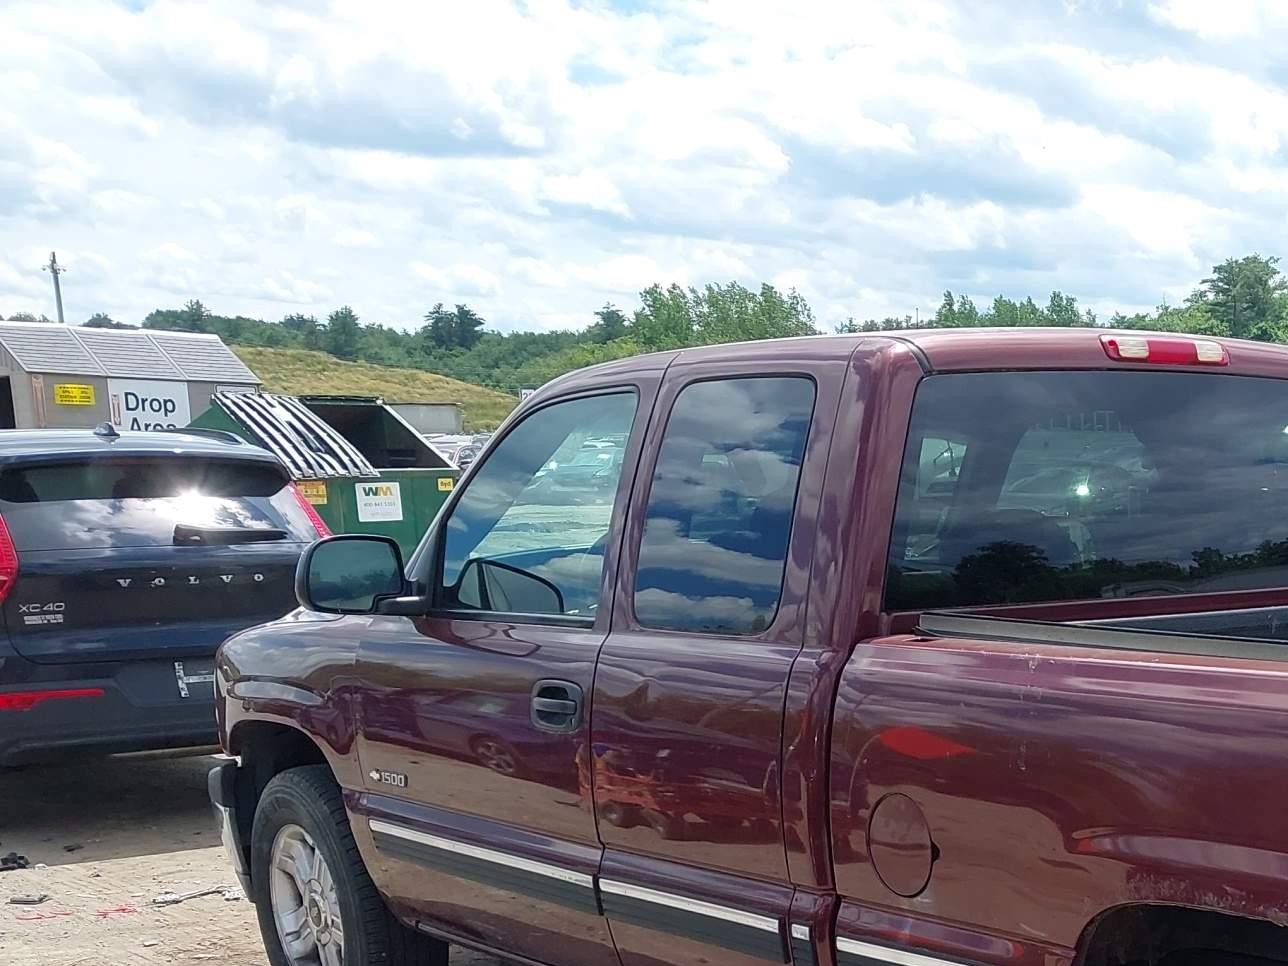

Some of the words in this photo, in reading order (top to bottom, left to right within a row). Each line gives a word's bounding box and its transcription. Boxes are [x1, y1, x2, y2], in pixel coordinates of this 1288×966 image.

[124, 391, 176, 417] Drop
[362, 486, 394, 496] WM
[116, 573, 265, 588] VOLVO
[18, 602, 65, 613] XC40
[381, 771, 405, 787] 1500
